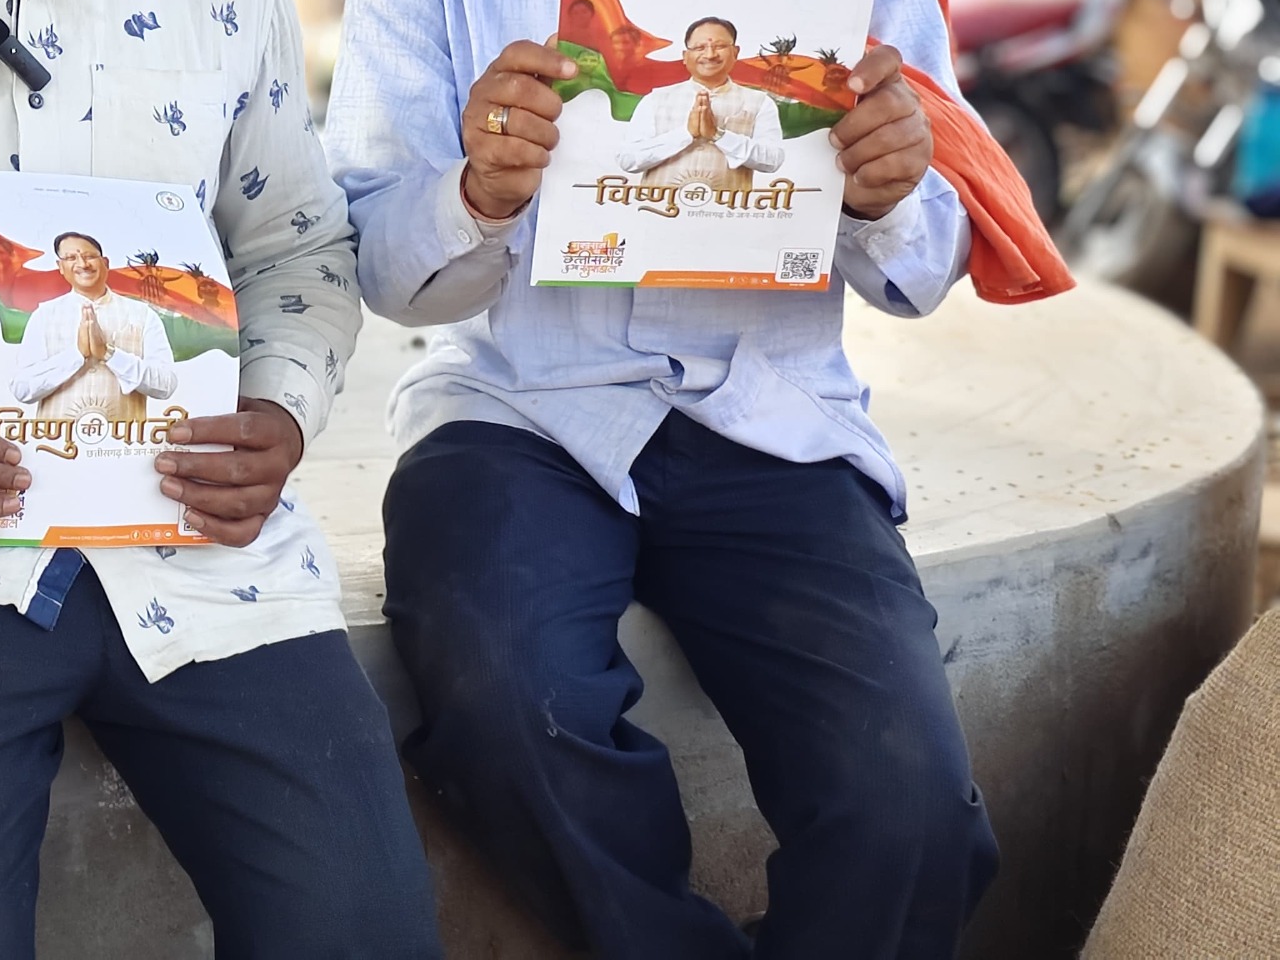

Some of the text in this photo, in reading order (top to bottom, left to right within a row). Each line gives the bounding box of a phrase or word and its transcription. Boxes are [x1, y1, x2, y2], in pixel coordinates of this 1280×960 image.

[595, 175, 795, 218] विष्णु की पाती
[81, 418, 104, 436] की
[124, 447, 132, 456] के
